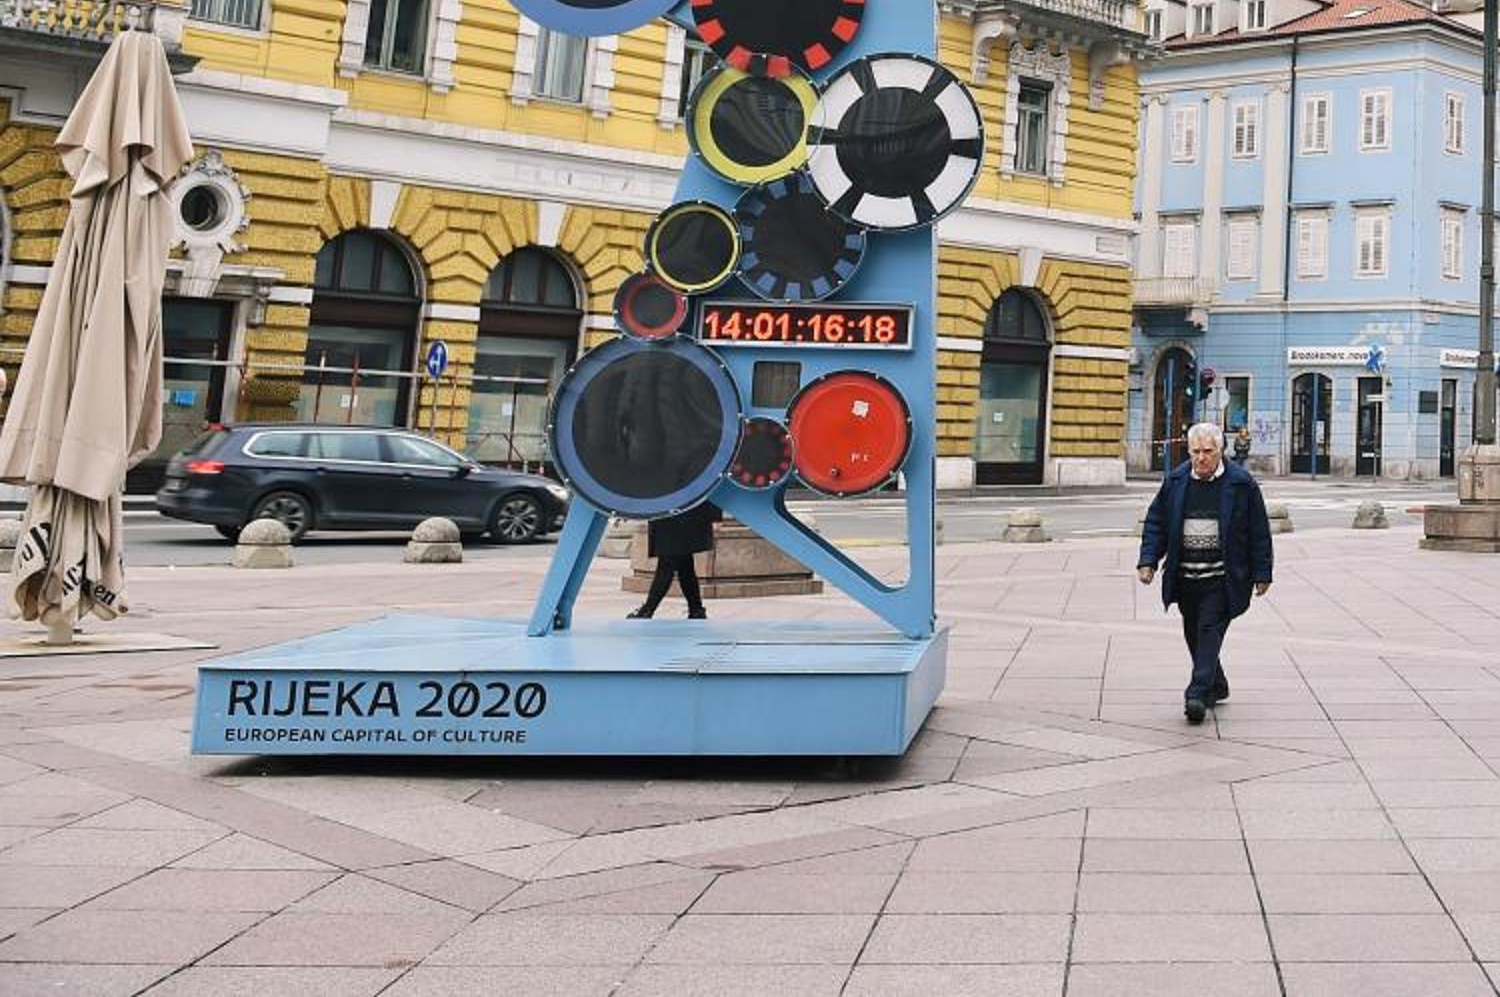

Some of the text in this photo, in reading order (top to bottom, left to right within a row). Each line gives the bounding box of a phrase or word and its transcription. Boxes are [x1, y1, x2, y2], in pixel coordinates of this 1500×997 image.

[704, 310, 896, 343] 14:01:16:18
[226, 680, 548, 718] RIJEKA 2020
[224, 728, 528, 744] EUROPEAN CAPITAL OF CULTURE
